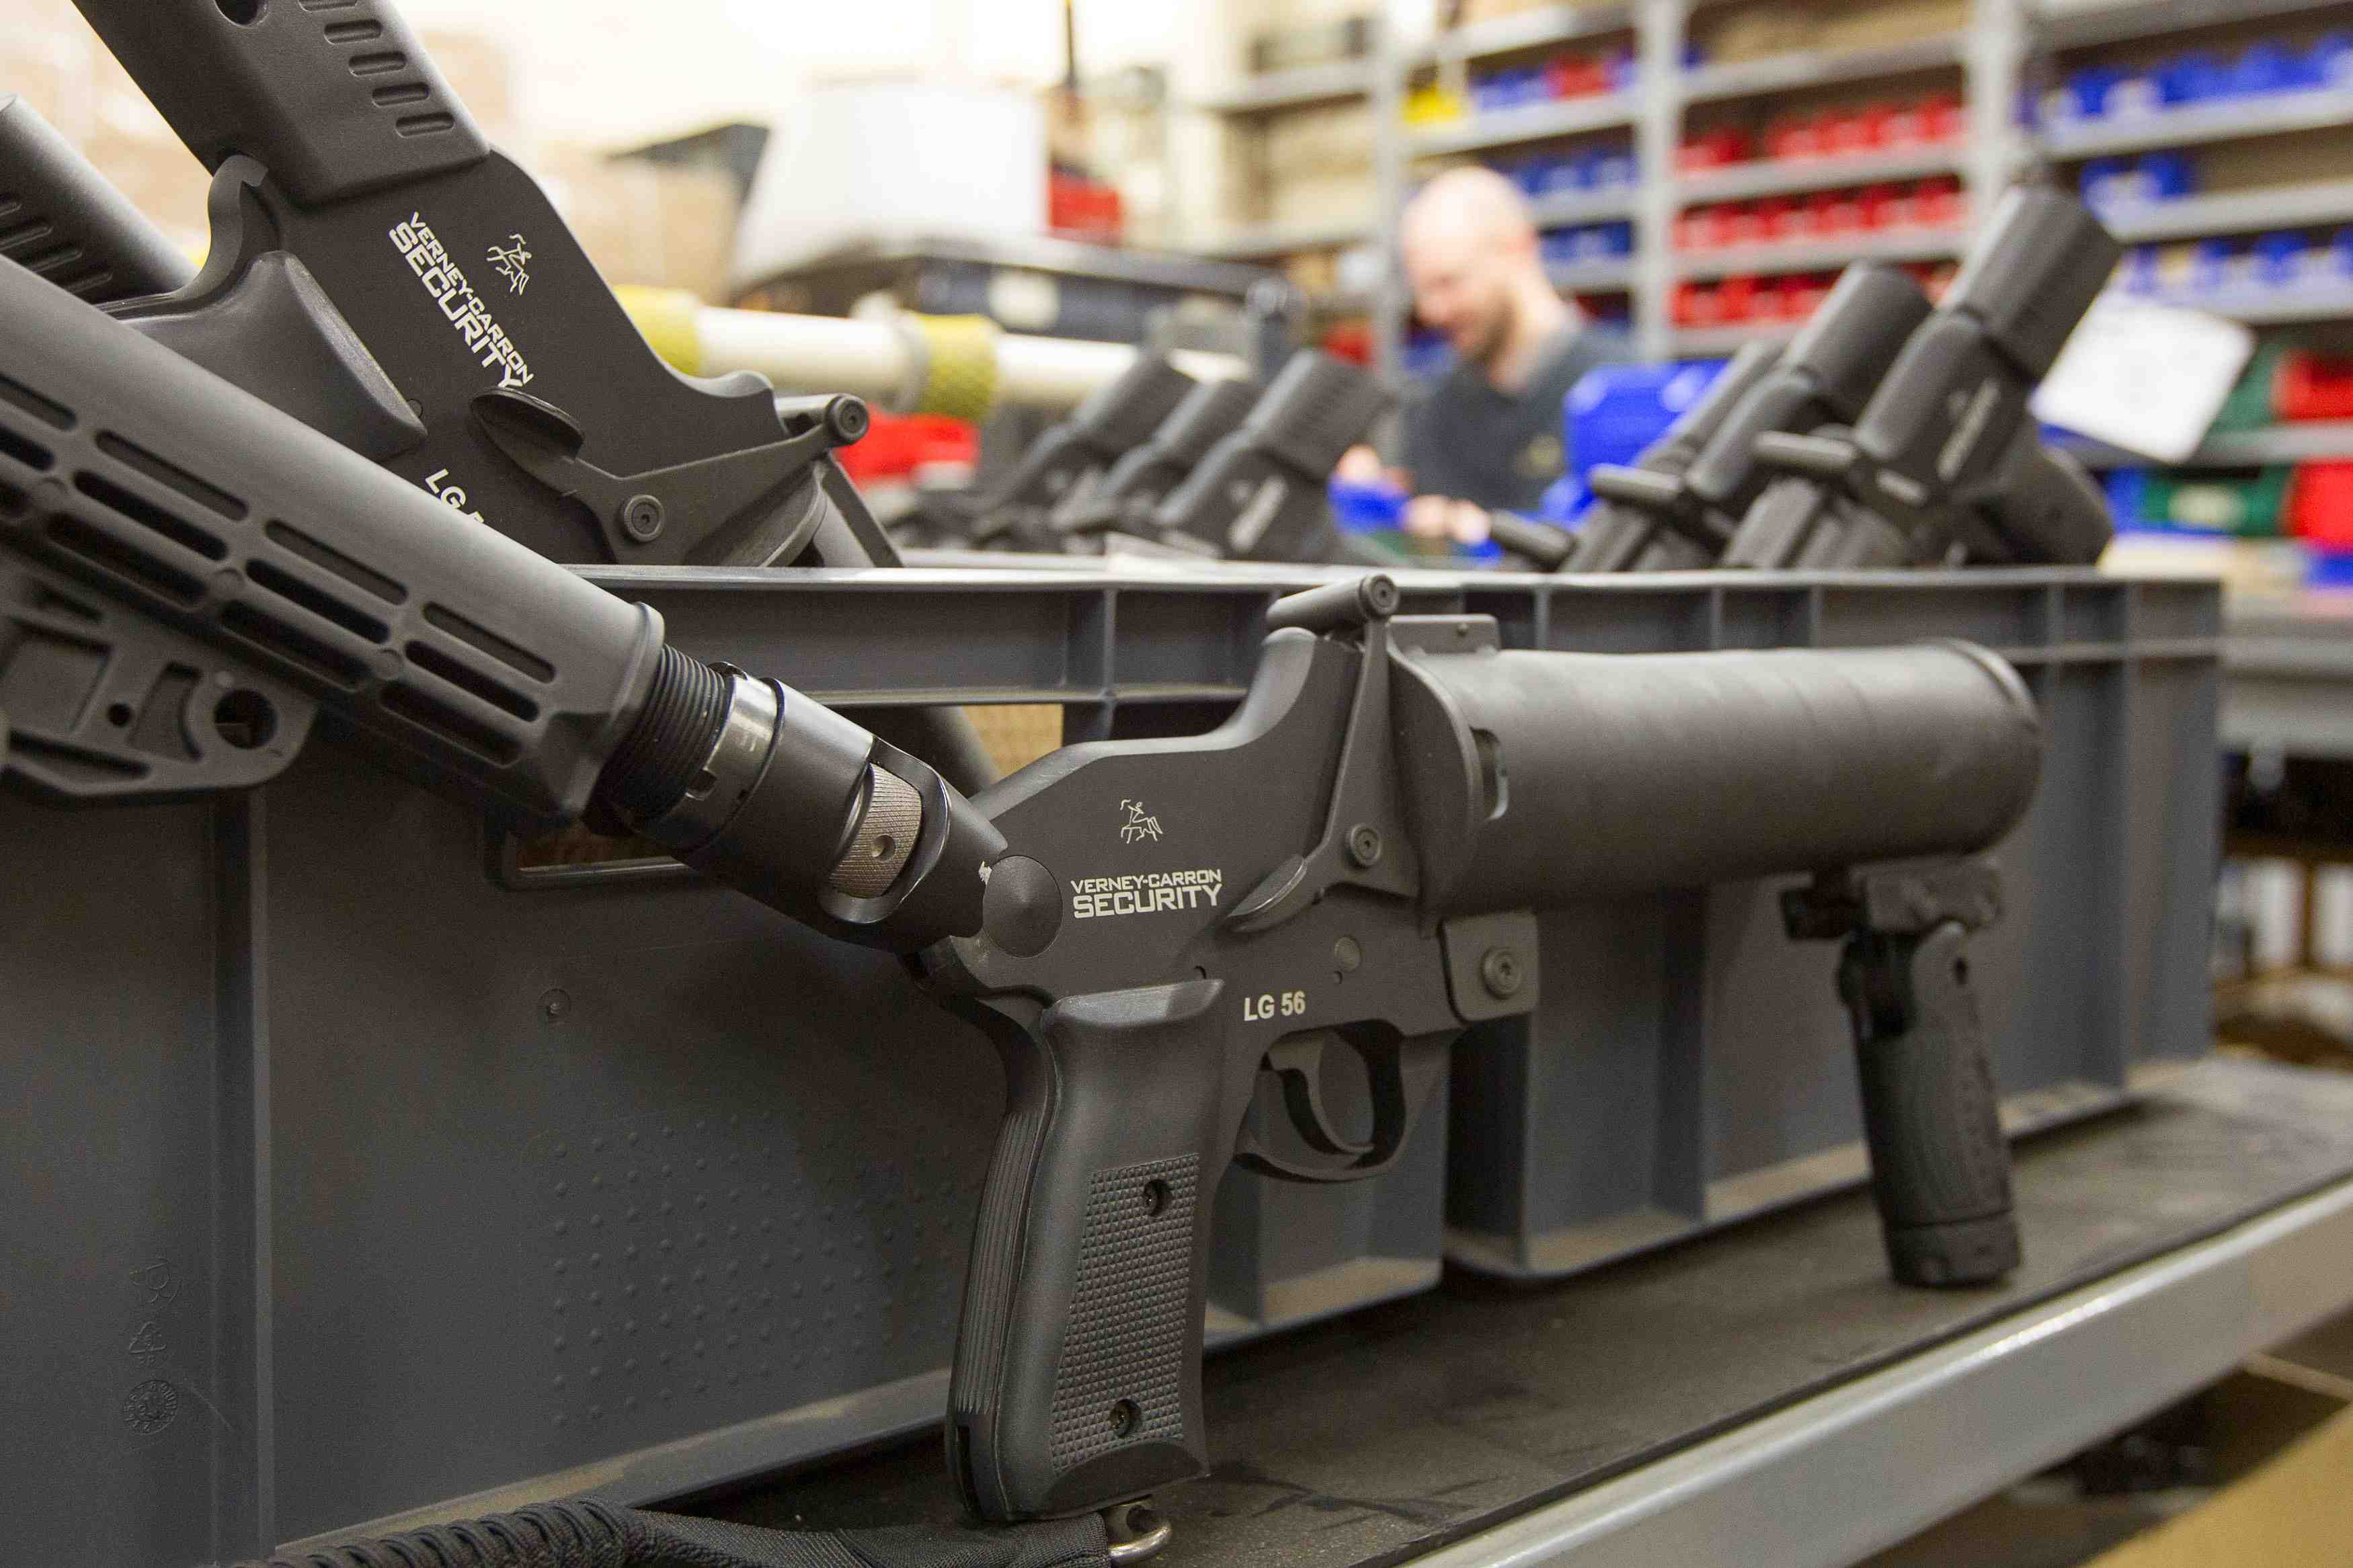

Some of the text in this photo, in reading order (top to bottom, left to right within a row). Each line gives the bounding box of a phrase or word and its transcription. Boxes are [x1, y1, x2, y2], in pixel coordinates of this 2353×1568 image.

[389, 222, 523, 388] SECURITY
[411, 212, 534, 385] VERNEY-CARRON
[425, 468, 467, 509] LG
[1070, 869, 1222, 894] VERNEY-CARRON
[1073, 884, 1222, 918] SECURITY
[1244, 991, 1306, 1021] LG 56
